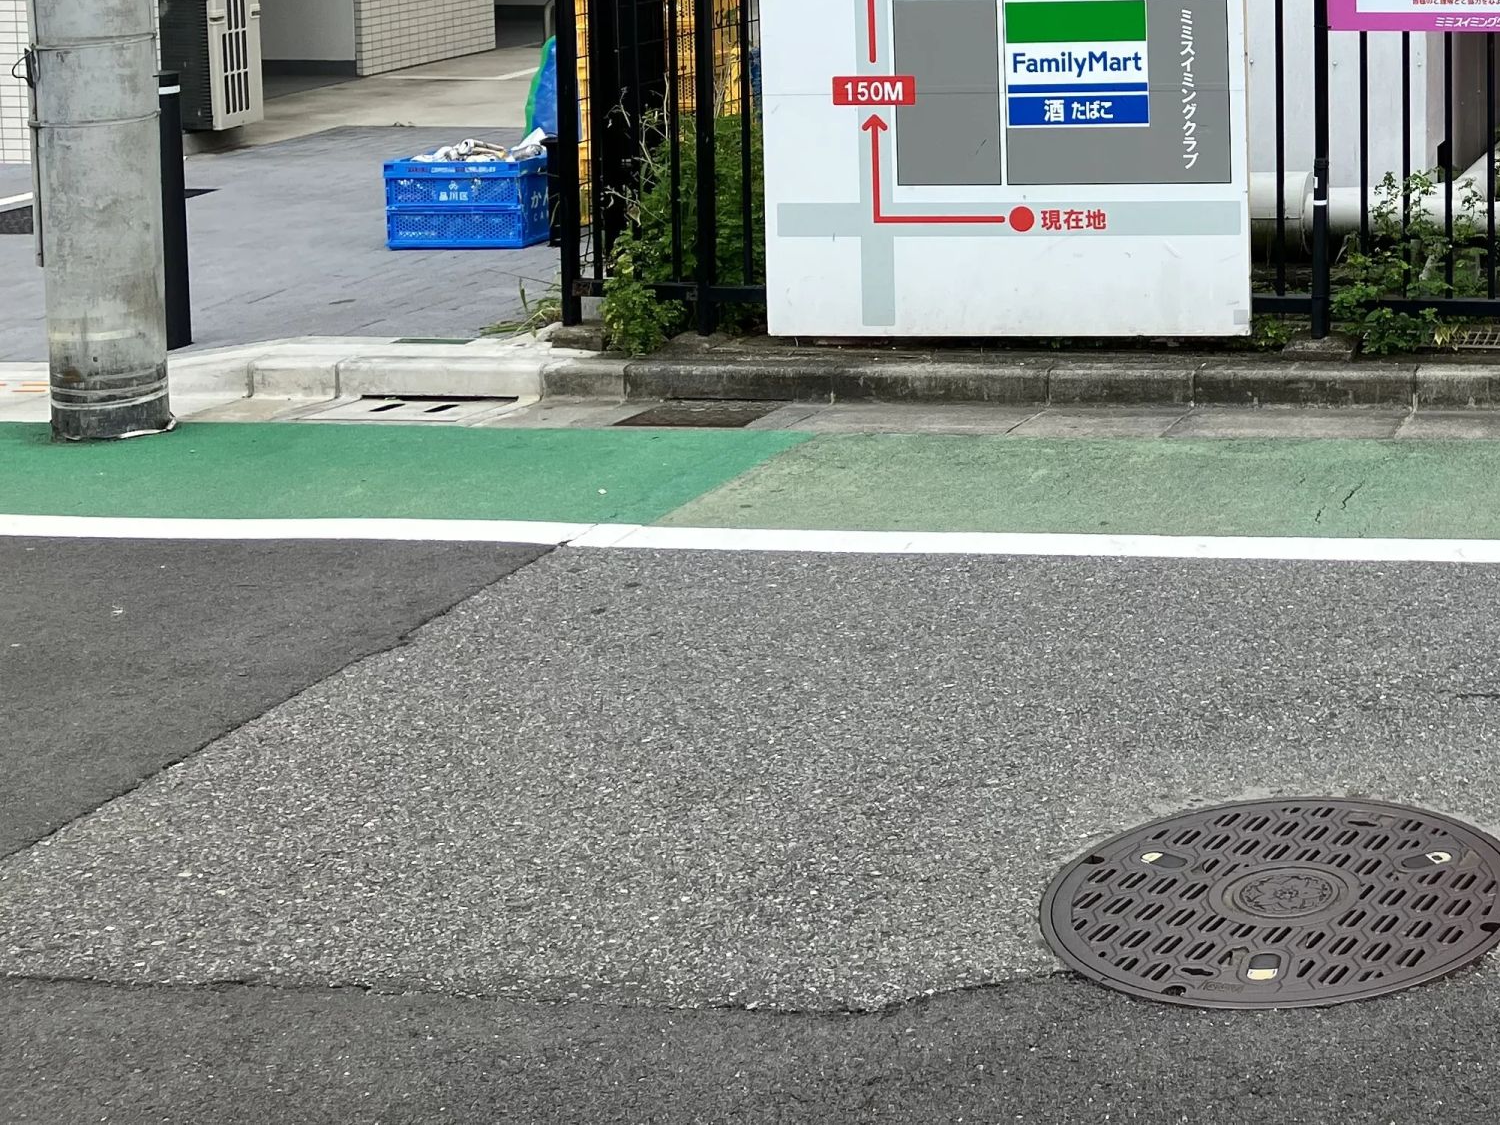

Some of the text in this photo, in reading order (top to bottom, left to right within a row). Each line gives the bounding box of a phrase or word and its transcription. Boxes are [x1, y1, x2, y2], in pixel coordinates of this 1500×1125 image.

[1012, 51, 1142, 77] FamilyMart
[843, 81, 903, 102] 150M
[1179, 9, 1200, 170] ミミスイミングクラブ
[1044, 99, 1114, 122] 酒 たばこ
[1040, 209, 1106, 231] 現在地
